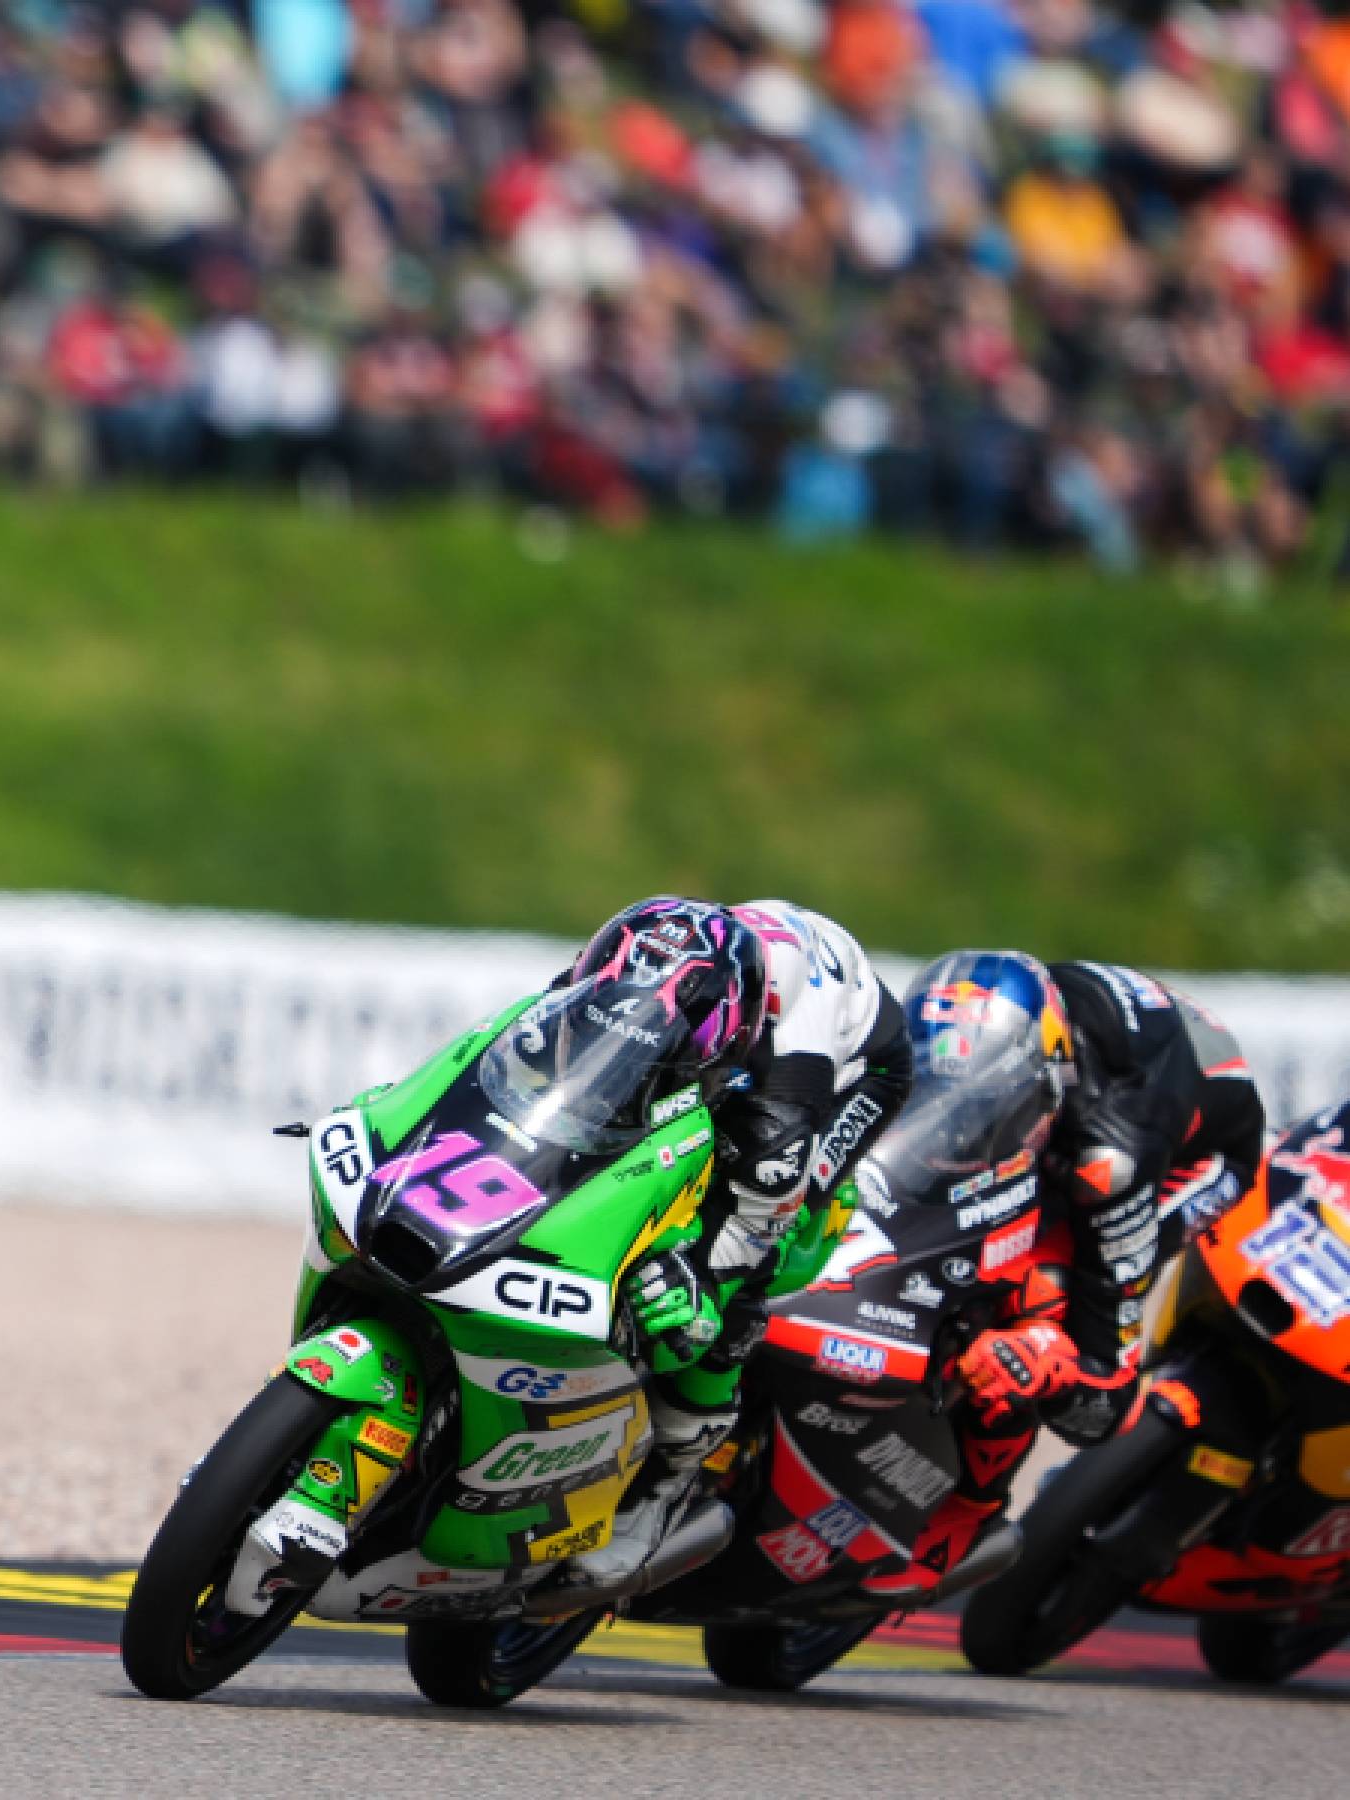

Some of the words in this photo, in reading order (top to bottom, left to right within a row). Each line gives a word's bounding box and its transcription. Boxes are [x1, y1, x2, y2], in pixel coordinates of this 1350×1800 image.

[584, 1004, 660, 1047] SHARK
[320, 1122, 364, 1186] CIP
[367, 1131, 546, 1231] 19
[493, 1270, 593, 1318] CIP
[482, 1431, 611, 1480] Green
